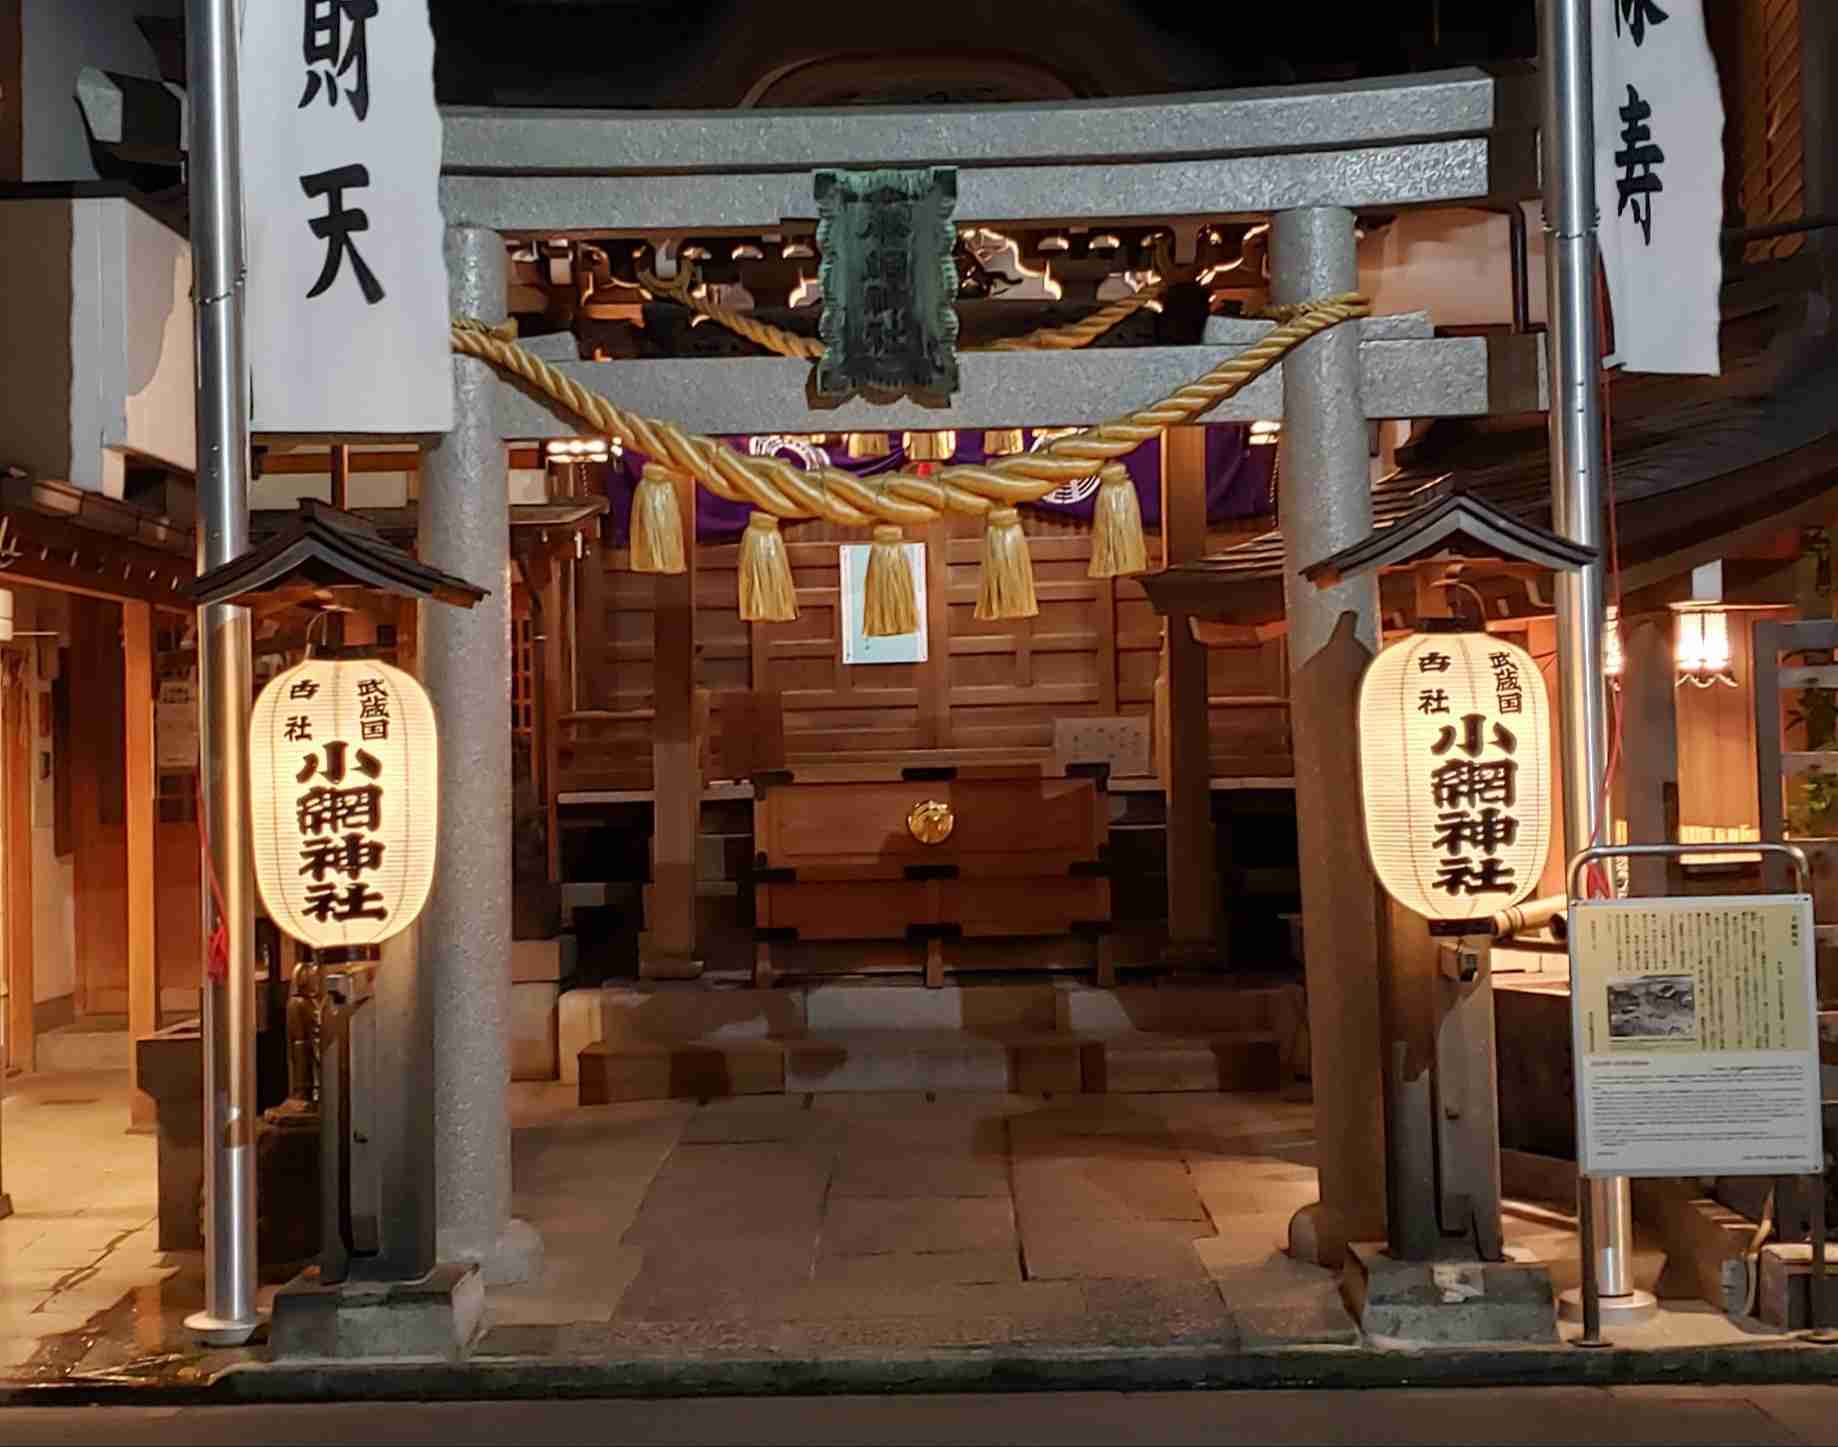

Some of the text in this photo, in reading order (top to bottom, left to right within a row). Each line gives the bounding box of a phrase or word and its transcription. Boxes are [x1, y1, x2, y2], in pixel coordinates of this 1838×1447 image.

[357, 678, 390, 741] 武蔵国
[1488, 651, 1523, 714] 武蔵国
[296, 740, 388, 924] 小網神社
[1430, 712, 1519, 897] 小網神社
